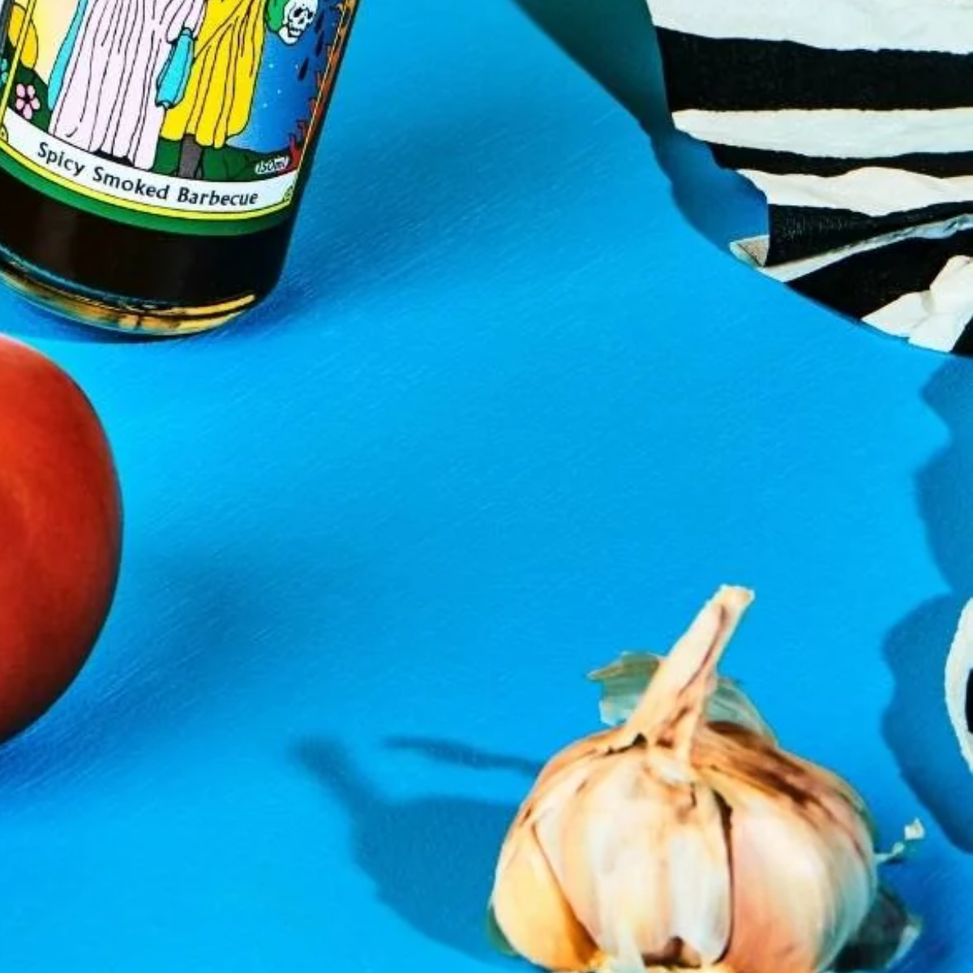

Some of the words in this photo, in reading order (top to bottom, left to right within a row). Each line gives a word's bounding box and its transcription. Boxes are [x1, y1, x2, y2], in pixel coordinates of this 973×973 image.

[36, 141, 86, 176] Spicy
[92, 166, 170, 201] Smoked
[176, 186, 259, 207] Barbecue
